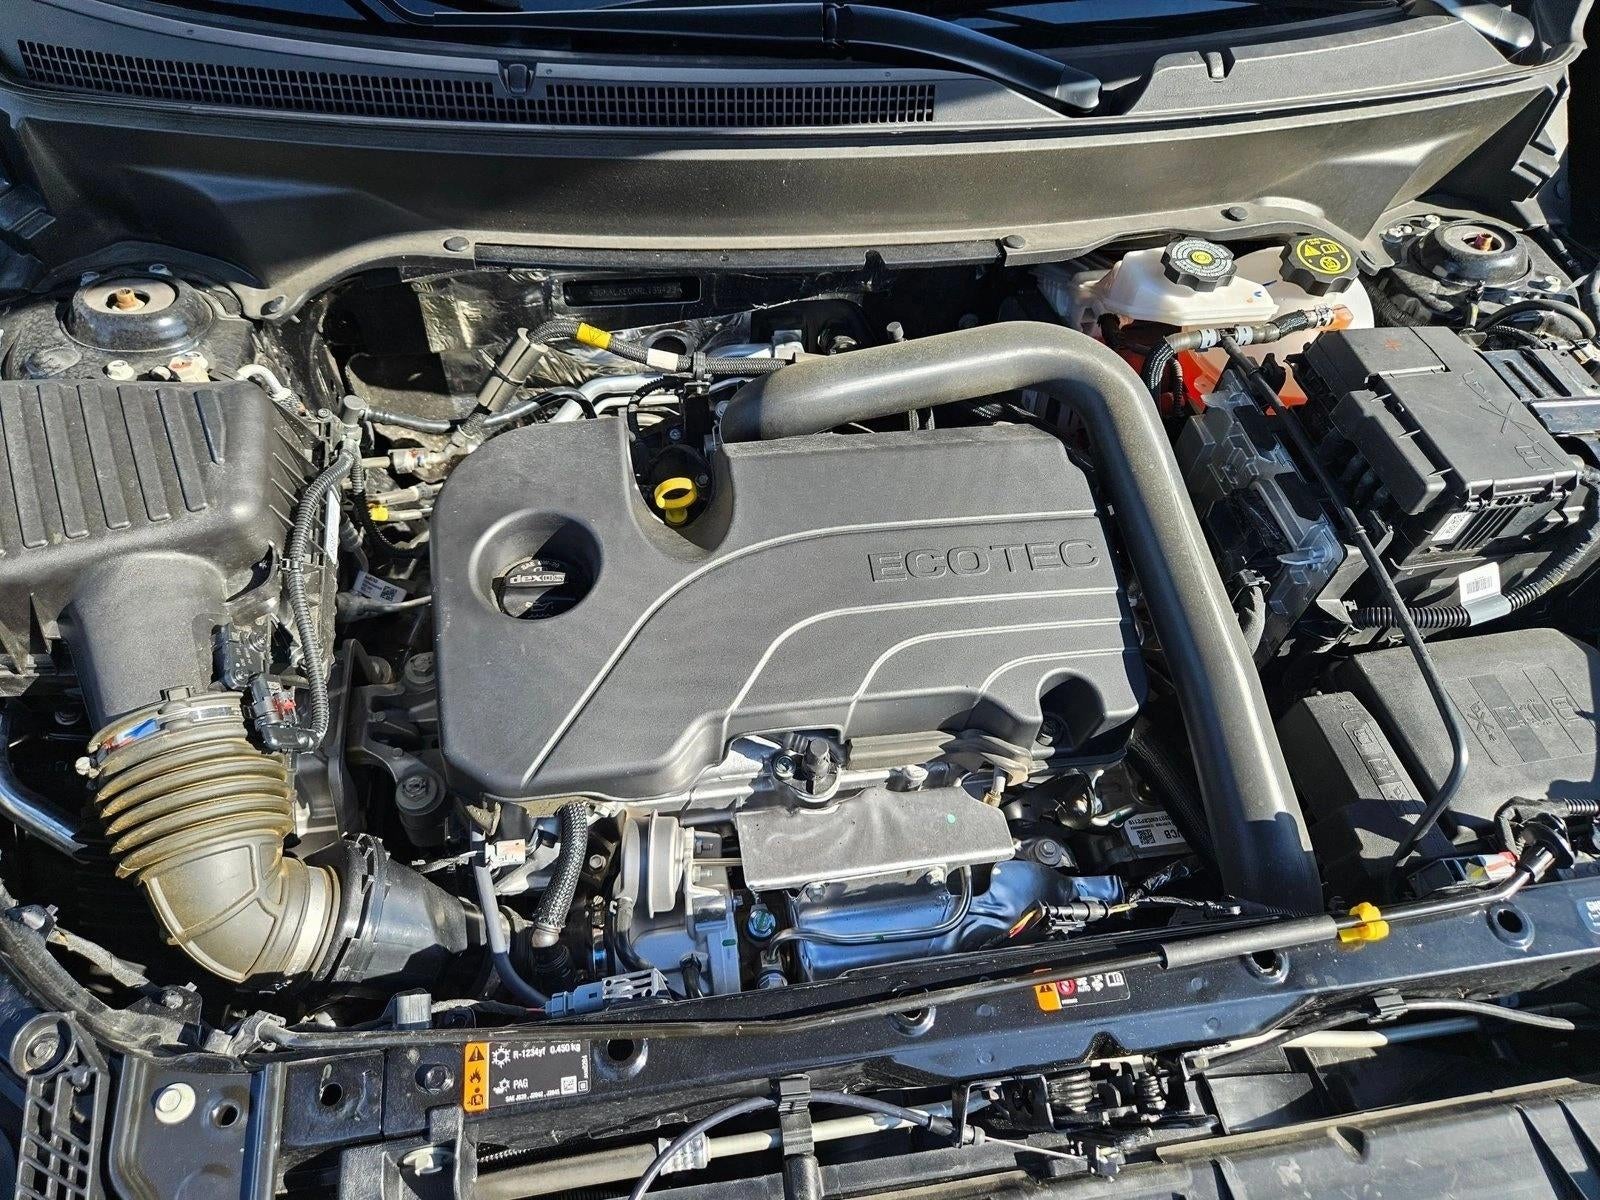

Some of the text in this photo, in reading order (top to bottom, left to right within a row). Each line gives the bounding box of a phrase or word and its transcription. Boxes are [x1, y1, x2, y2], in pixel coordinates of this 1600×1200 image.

[868, 538, 1100, 583] ECOTEC
[509, 574, 566, 584] dexos
[513, 1047, 546, 1059] R-1234yf
[571, 1043, 581, 1053] kg
[513, 1078, 529, 1090] PAG
